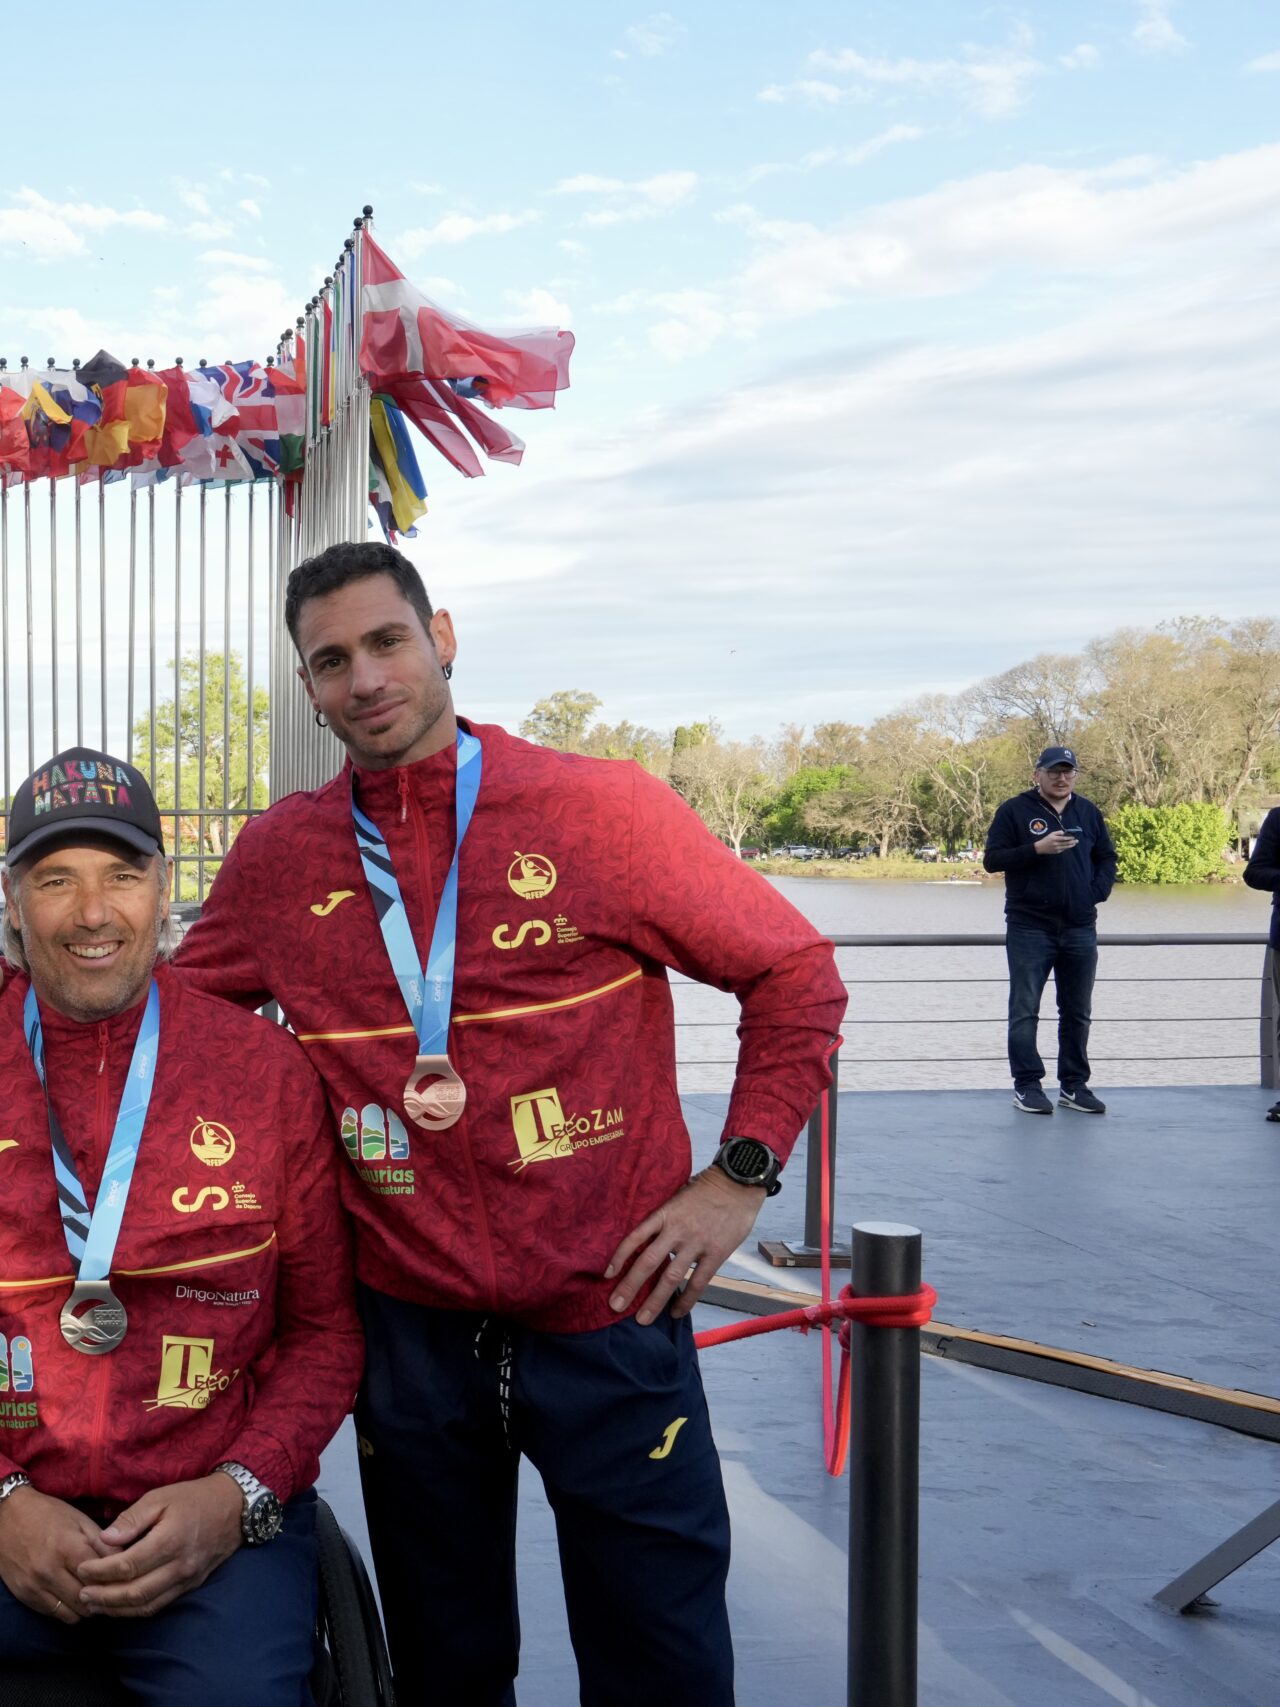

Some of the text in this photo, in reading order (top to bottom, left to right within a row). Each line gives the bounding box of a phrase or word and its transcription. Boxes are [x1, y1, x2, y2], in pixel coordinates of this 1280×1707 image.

[32, 760, 132, 796] HAKUNA
[33, 781, 133, 816] MATATA
[559, 1139, 588, 1152] GRUPO
[175, 1285, 261, 1302] DingoNatura
[6, 1417, 40, 1430] natural
